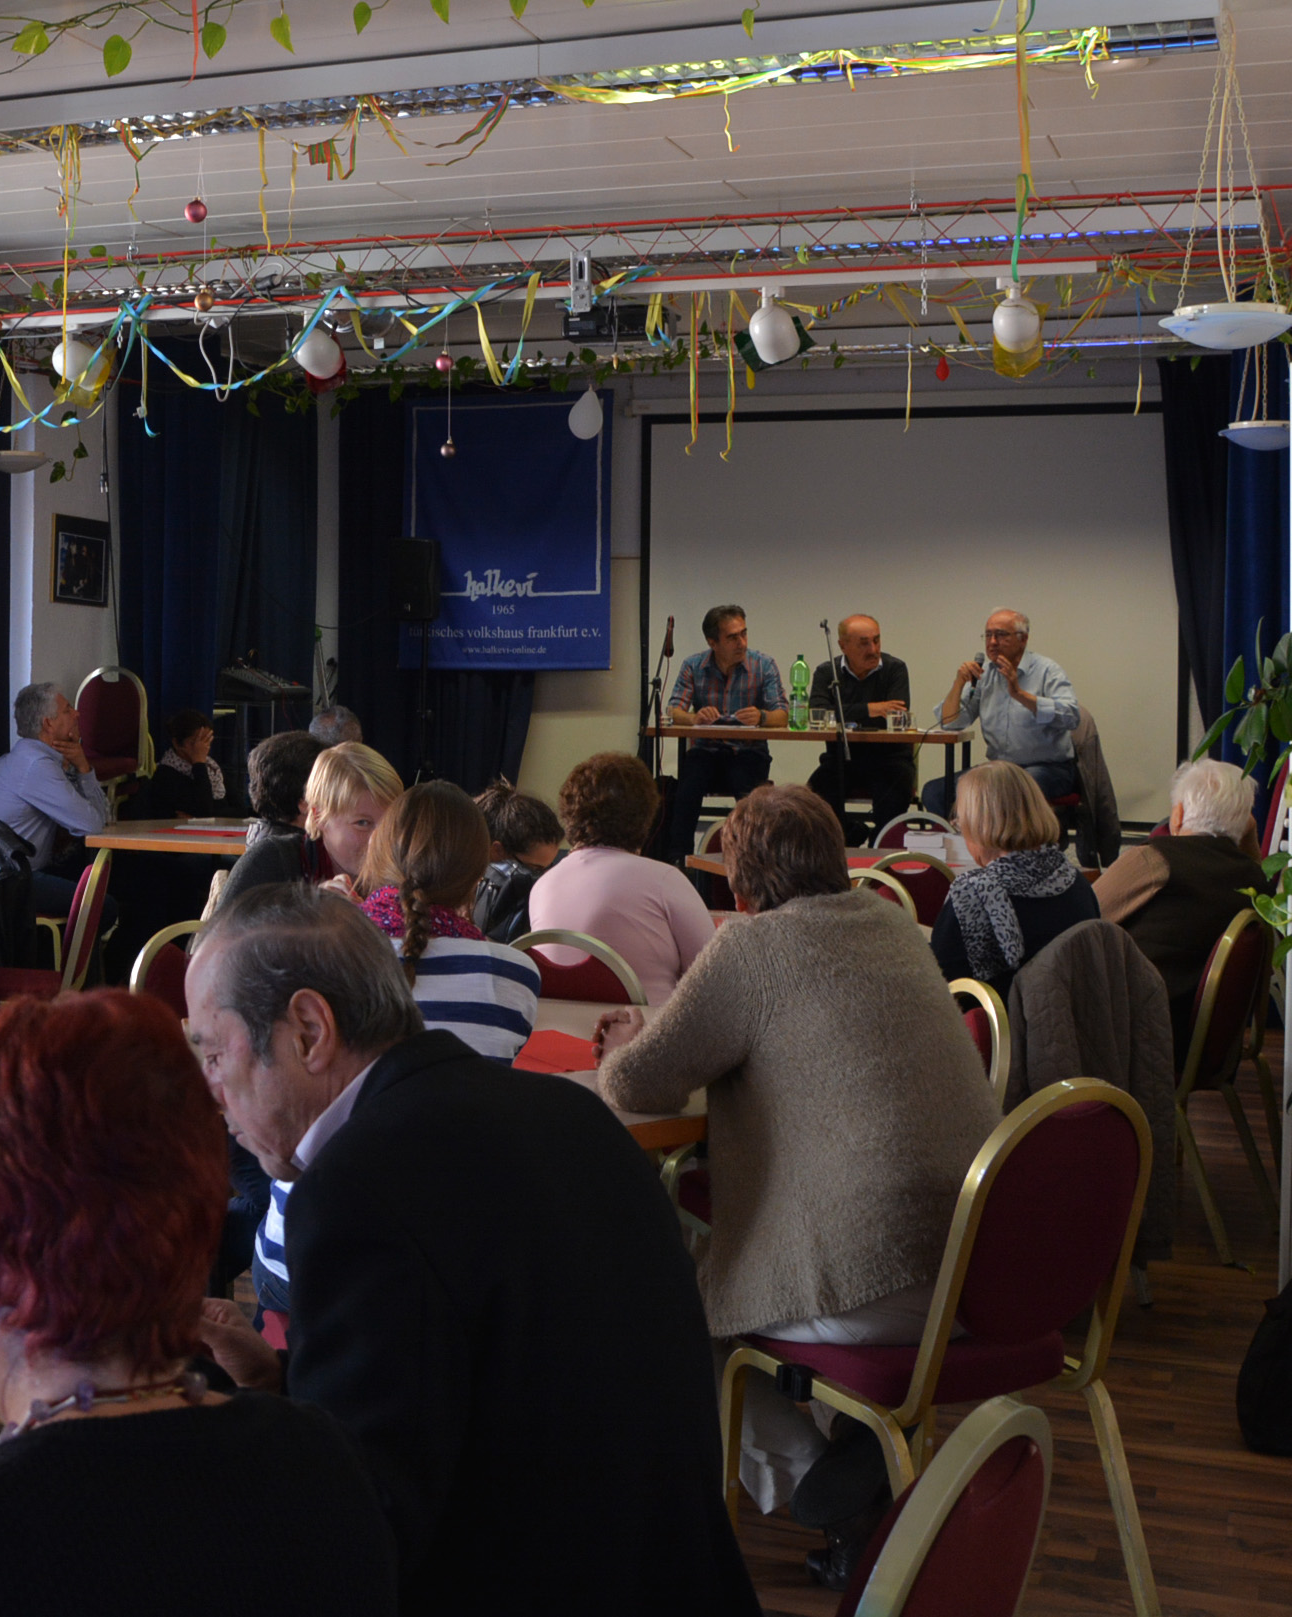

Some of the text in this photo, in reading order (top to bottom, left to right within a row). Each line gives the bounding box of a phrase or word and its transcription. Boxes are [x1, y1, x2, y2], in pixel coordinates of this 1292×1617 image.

[491, 604, 515, 615] 1965
[467, 625, 524, 639] volkshaus
[527, 625, 578, 638] frankfurt
[581, 626, 601, 638] e.v.
[462, 644, 547, 655] www.halkevi-online.de
